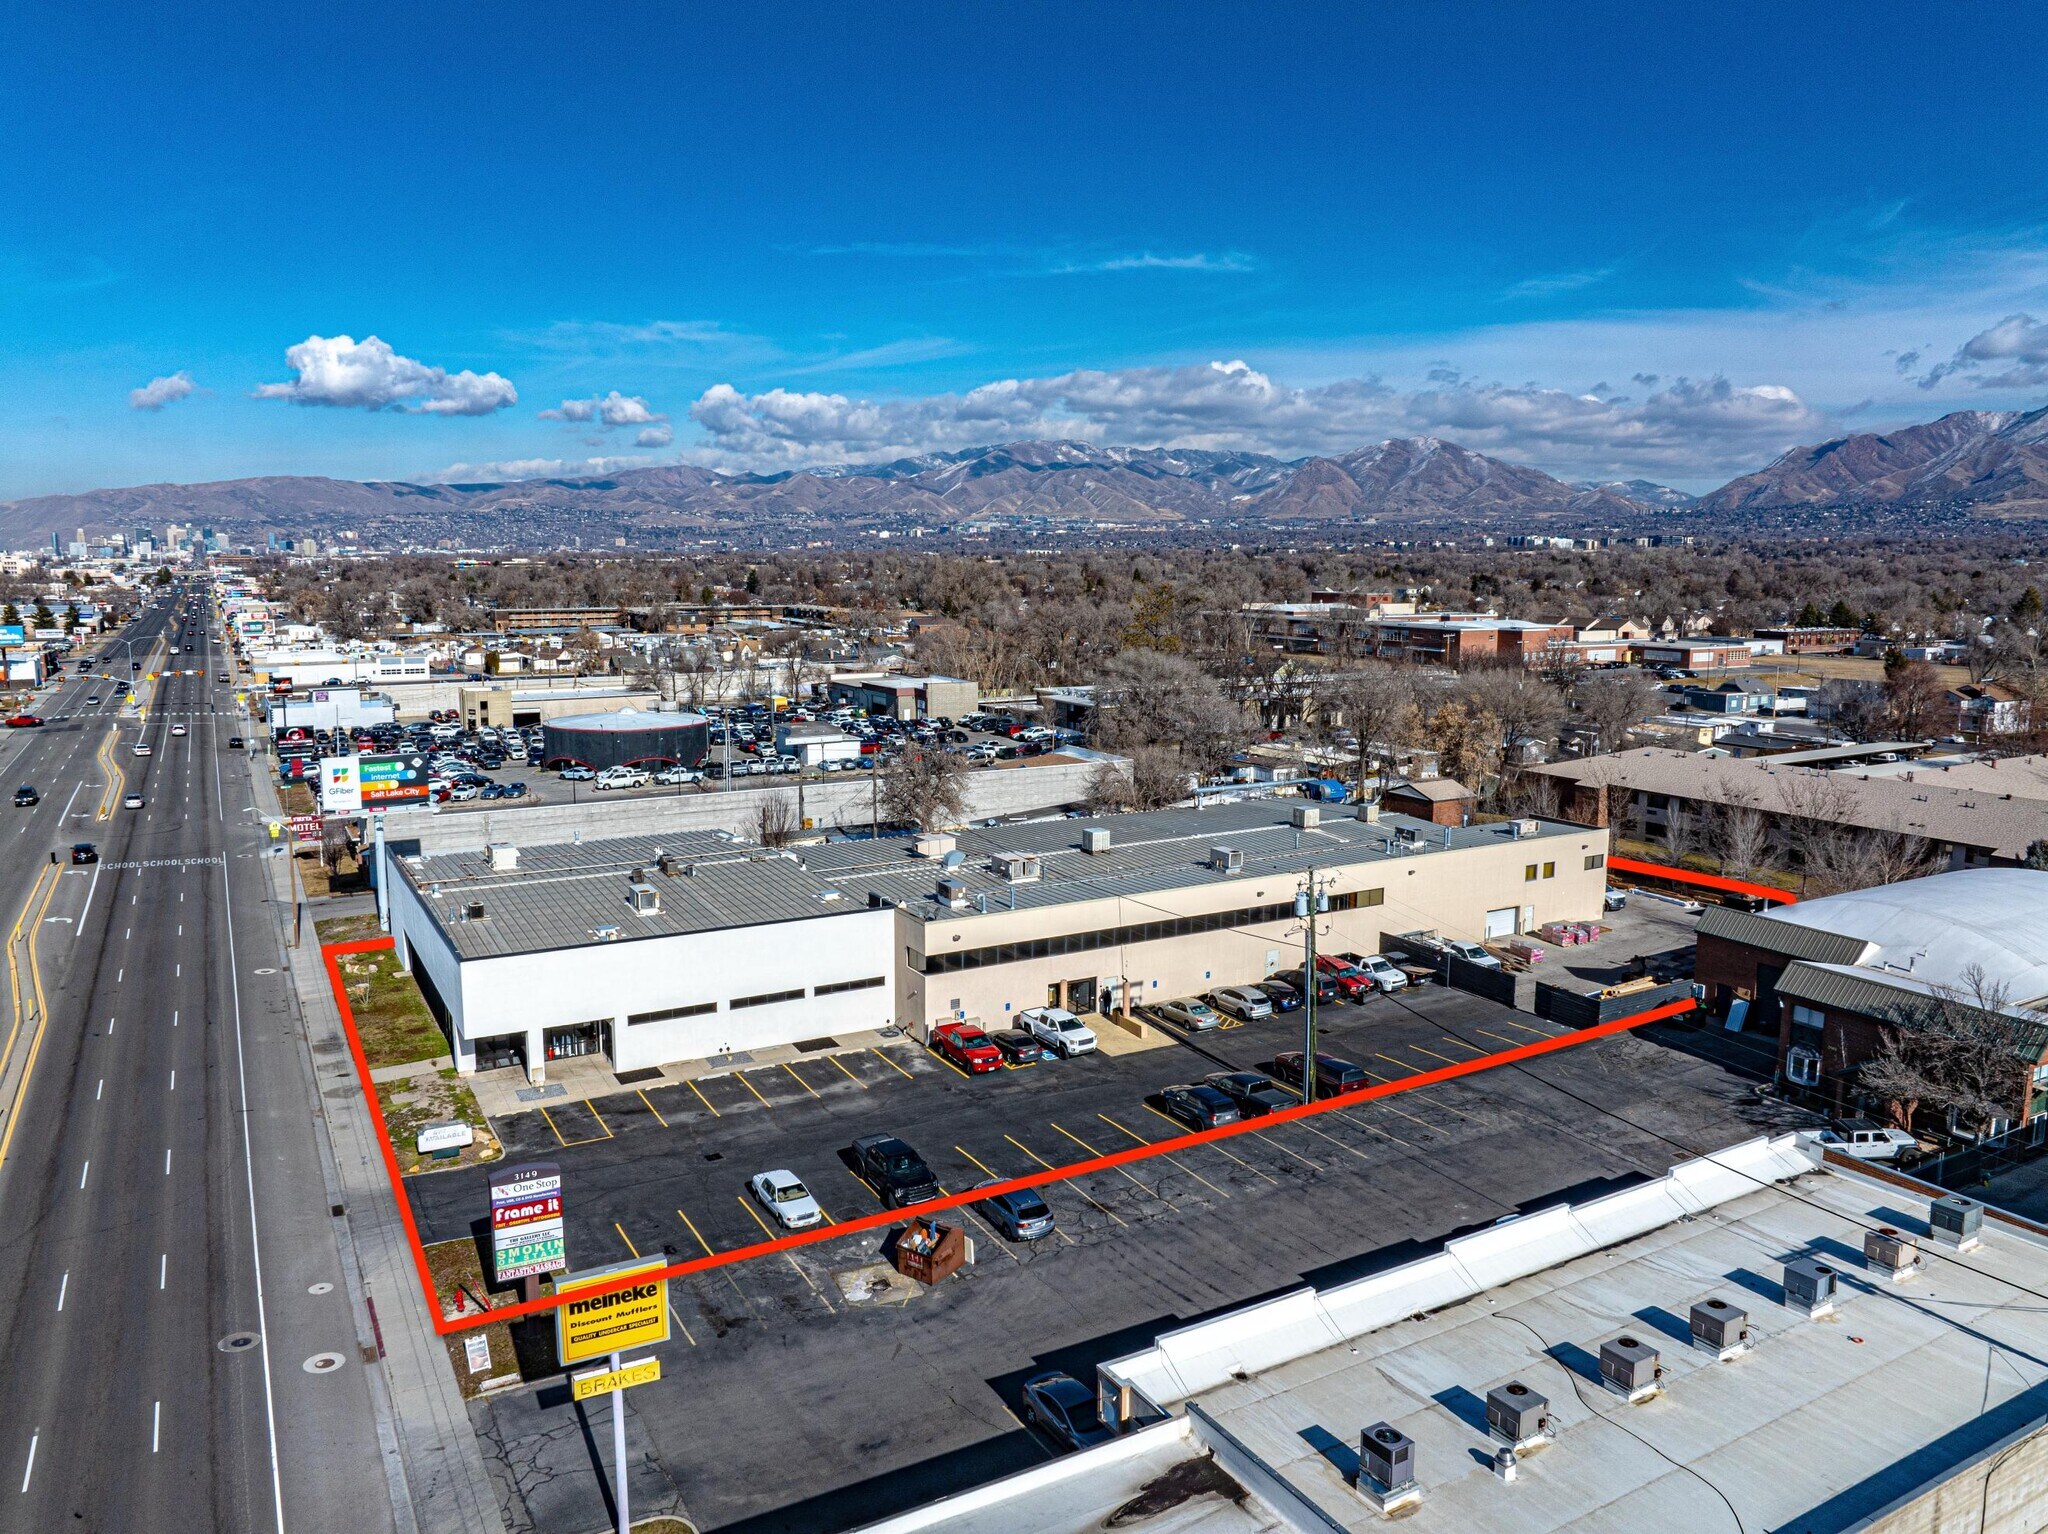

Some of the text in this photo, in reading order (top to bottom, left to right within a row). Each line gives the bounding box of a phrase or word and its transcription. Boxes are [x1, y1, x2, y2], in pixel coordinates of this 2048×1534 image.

[364, 764, 392, 772] Fastest
[404, 788, 420, 796] City
[290, 822, 322, 832] MOTEL
[99, 862, 142, 870] SCHOOL
[142, 860, 184, 868] SCHOOL
[514, 1170, 538, 1180] 3149
[514, 1180, 558, 1192] One Stop
[548, 1198, 559, 1212] it
[497, 1240, 564, 1260] SMOKIN
[498, 1258, 514, 1266] ON
[524, 1248, 564, 1260] STATE
[498, 1266, 536, 1280] FANTASTIC
[569, 1284, 657, 1315] meineke
[570, 1304, 658, 1328] Discount Mufflers
[574, 1318, 657, 1342] QUALITY UNDERCAR SPECIALIST
[580, 1366, 656, 1396] BRAKES
